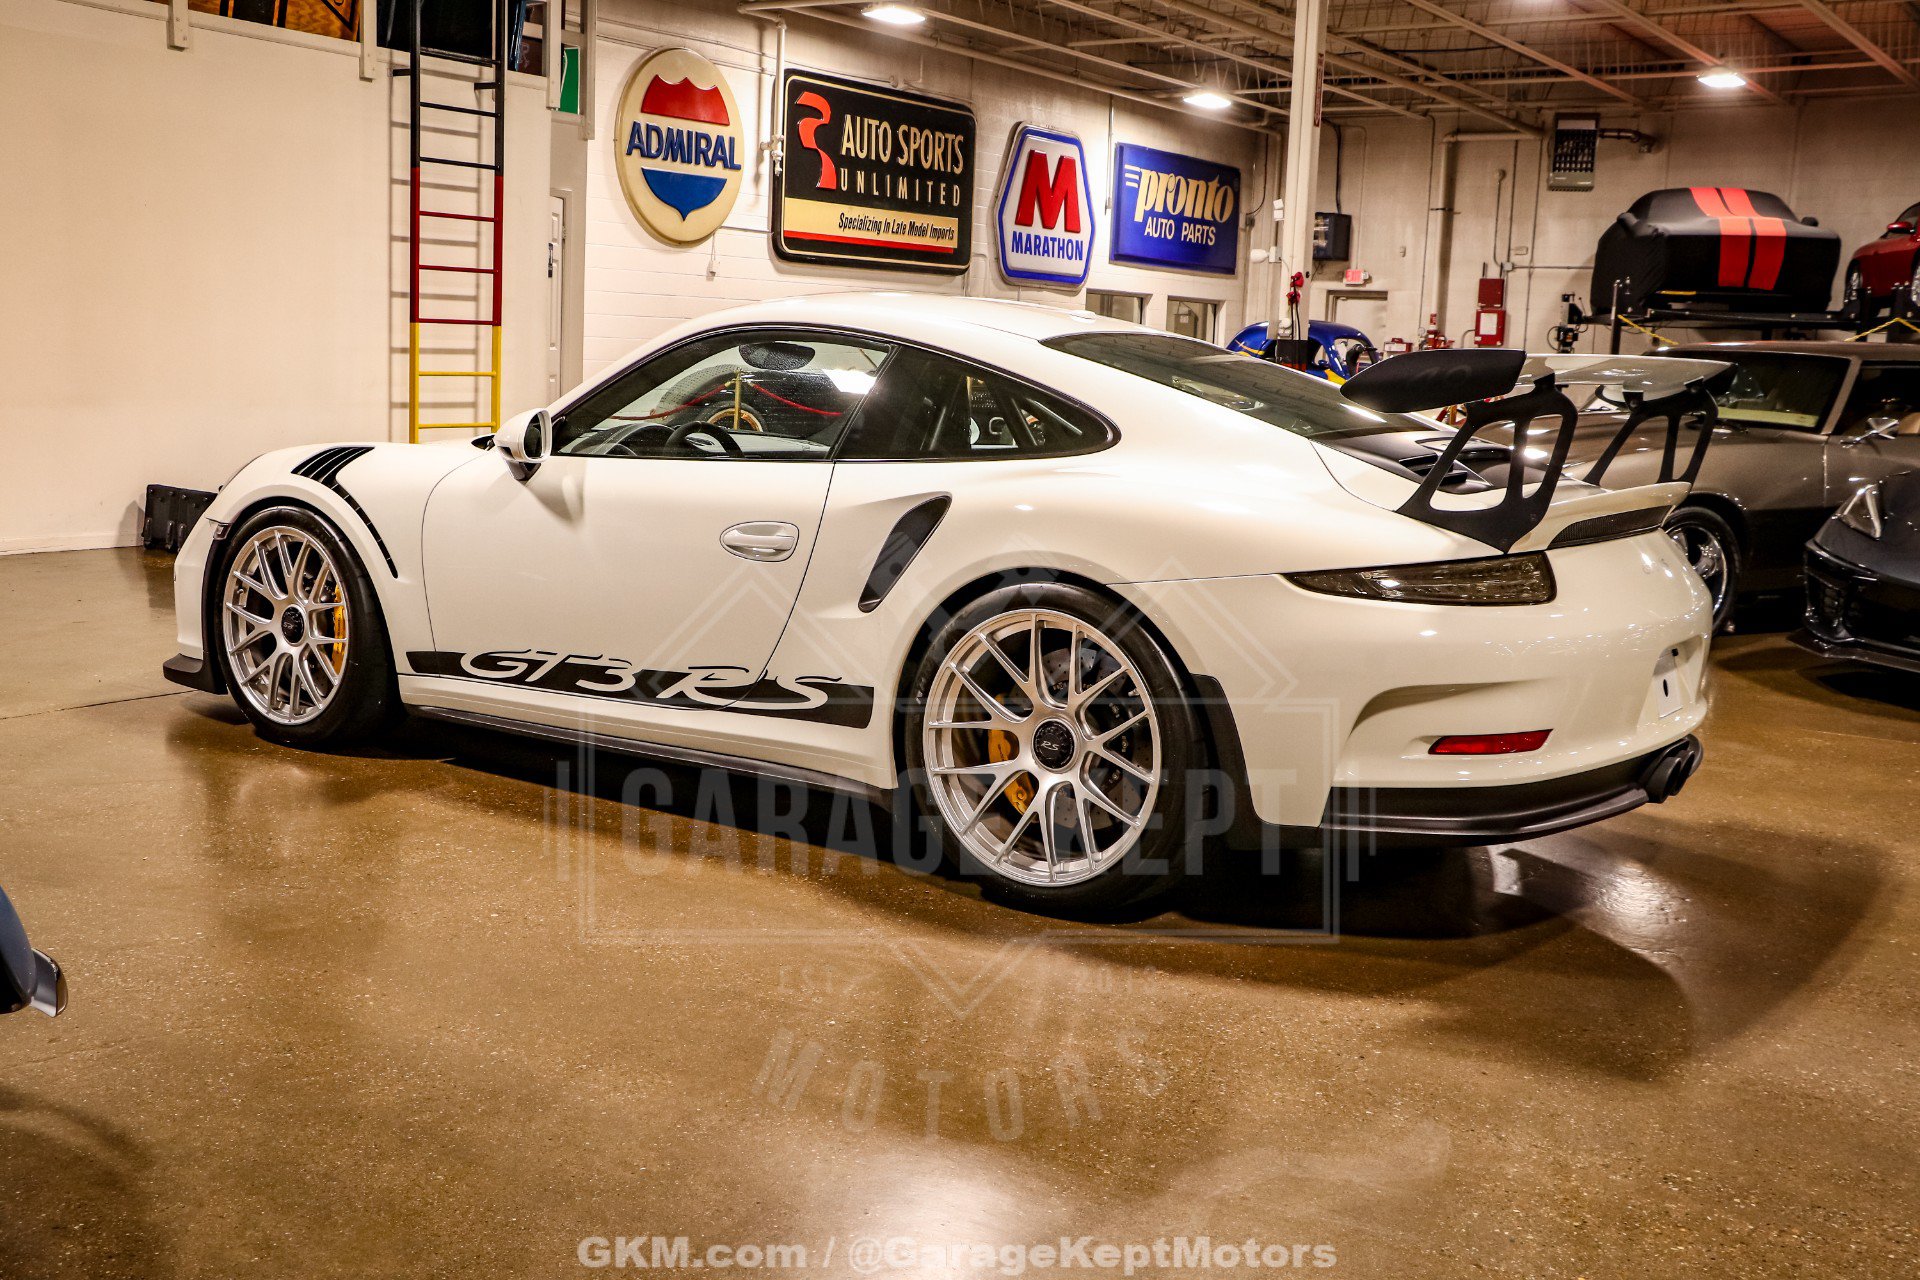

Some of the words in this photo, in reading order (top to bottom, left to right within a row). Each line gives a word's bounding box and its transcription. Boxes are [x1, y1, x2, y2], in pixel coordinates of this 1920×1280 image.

[626, 120, 742, 170] ADMIRAL
[841, 114, 892, 163] AUTO
[897, 124, 964, 175] SPORTS
[840, 167, 960, 207] UNLIMITED
[1015, 149, 1081, 233] M
[1134, 168, 1234, 223] pronto
[838, 211, 882, 235] Specializing
[883, 218, 891, 234] In
[891, 218, 907, 235] Late
[907, 220, 930, 237] Model
[929, 223, 955, 242] Imports
[1012, 230, 1083, 261] MARATHON
[1144, 216, 1175, 240] AUTO
[1181, 221, 1216, 246] PARTS
[461, 649, 636, 692] GT3
[656, 665, 842, 710] RS
